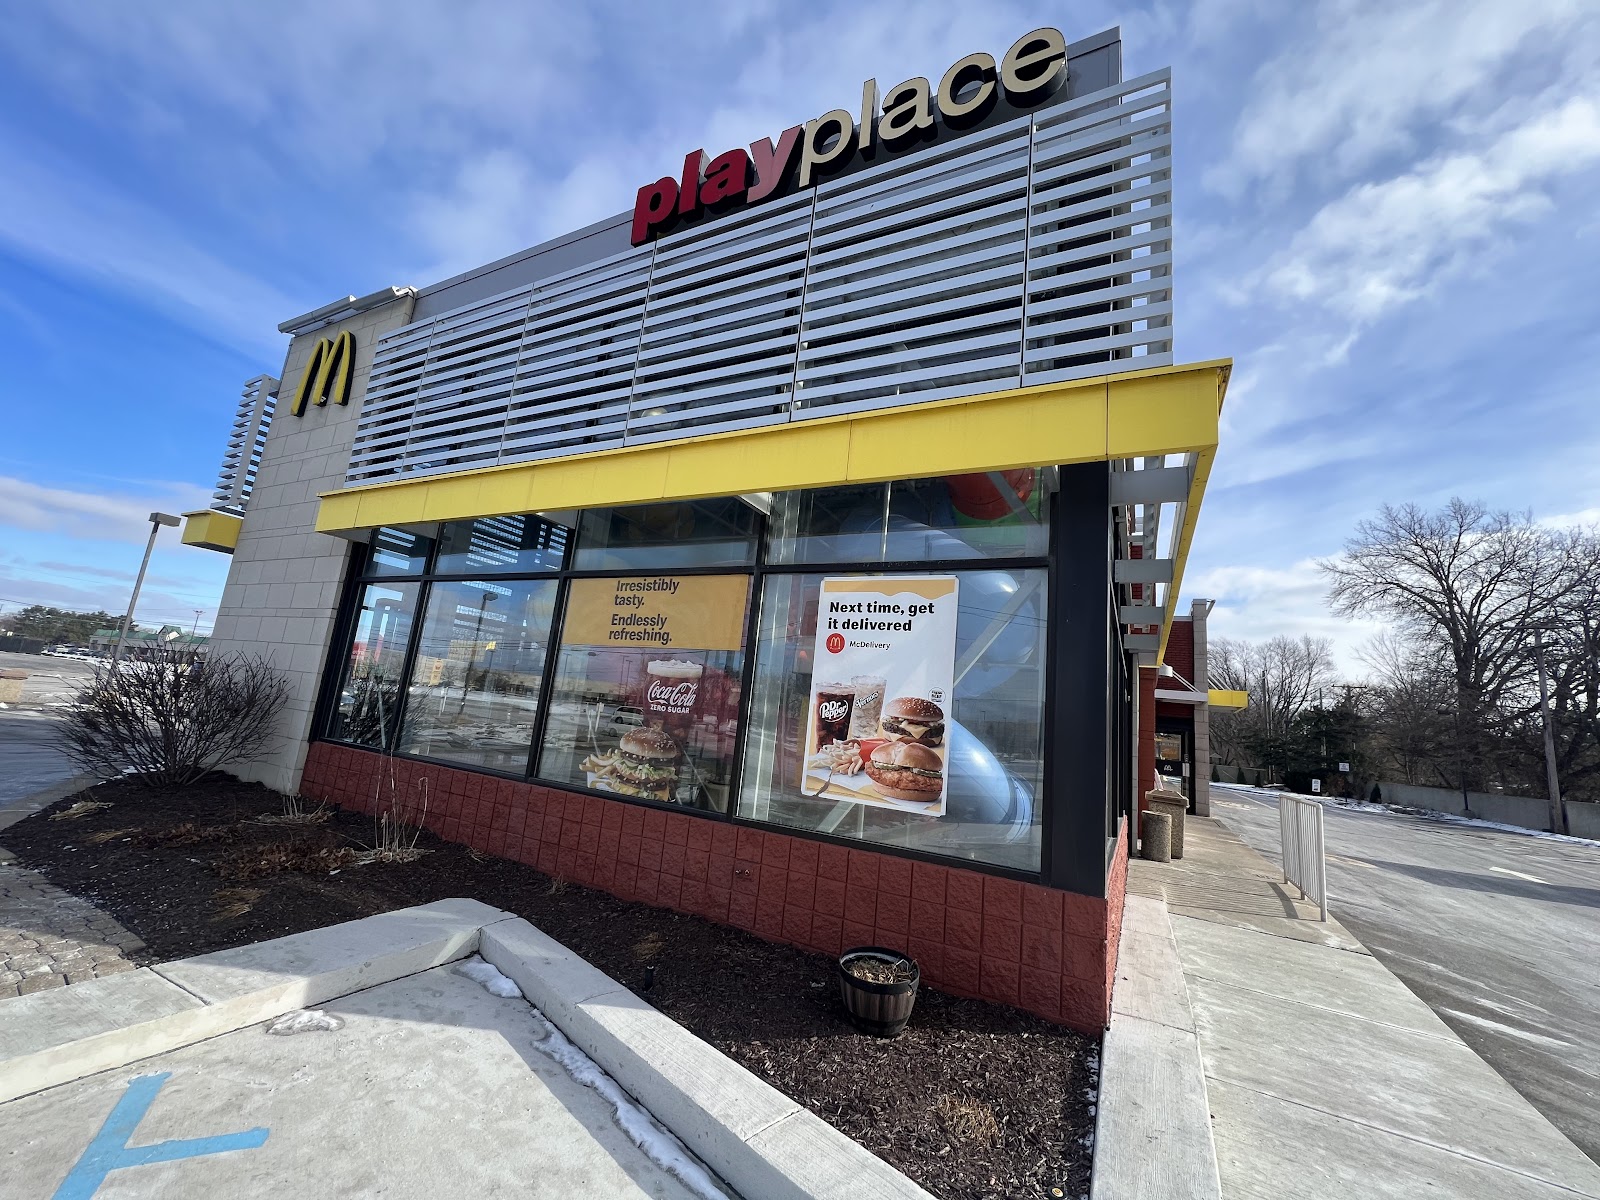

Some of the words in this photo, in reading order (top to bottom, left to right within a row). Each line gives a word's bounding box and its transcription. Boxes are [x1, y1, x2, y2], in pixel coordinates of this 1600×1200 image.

[616, 578, 680, 595] Irresistibly
[614, 594, 645, 609] tasty.
[829, 601, 863, 613] Next
[866, 601, 905, 616] time,
[908, 602, 935, 617] get
[611, 613, 668, 630] Endlessly
[828, 617, 839, 630] it
[841, 617, 912, 632] delivered
[608, 628, 673, 645] refreshing.
[849, 640, 891, 651] McDelivery
[650, 704, 667, 712] ZERO
[667, 706, 690, 714] SUGAR
[821, 702, 848, 720] Pepper
[829, 700, 842, 711] Dr
